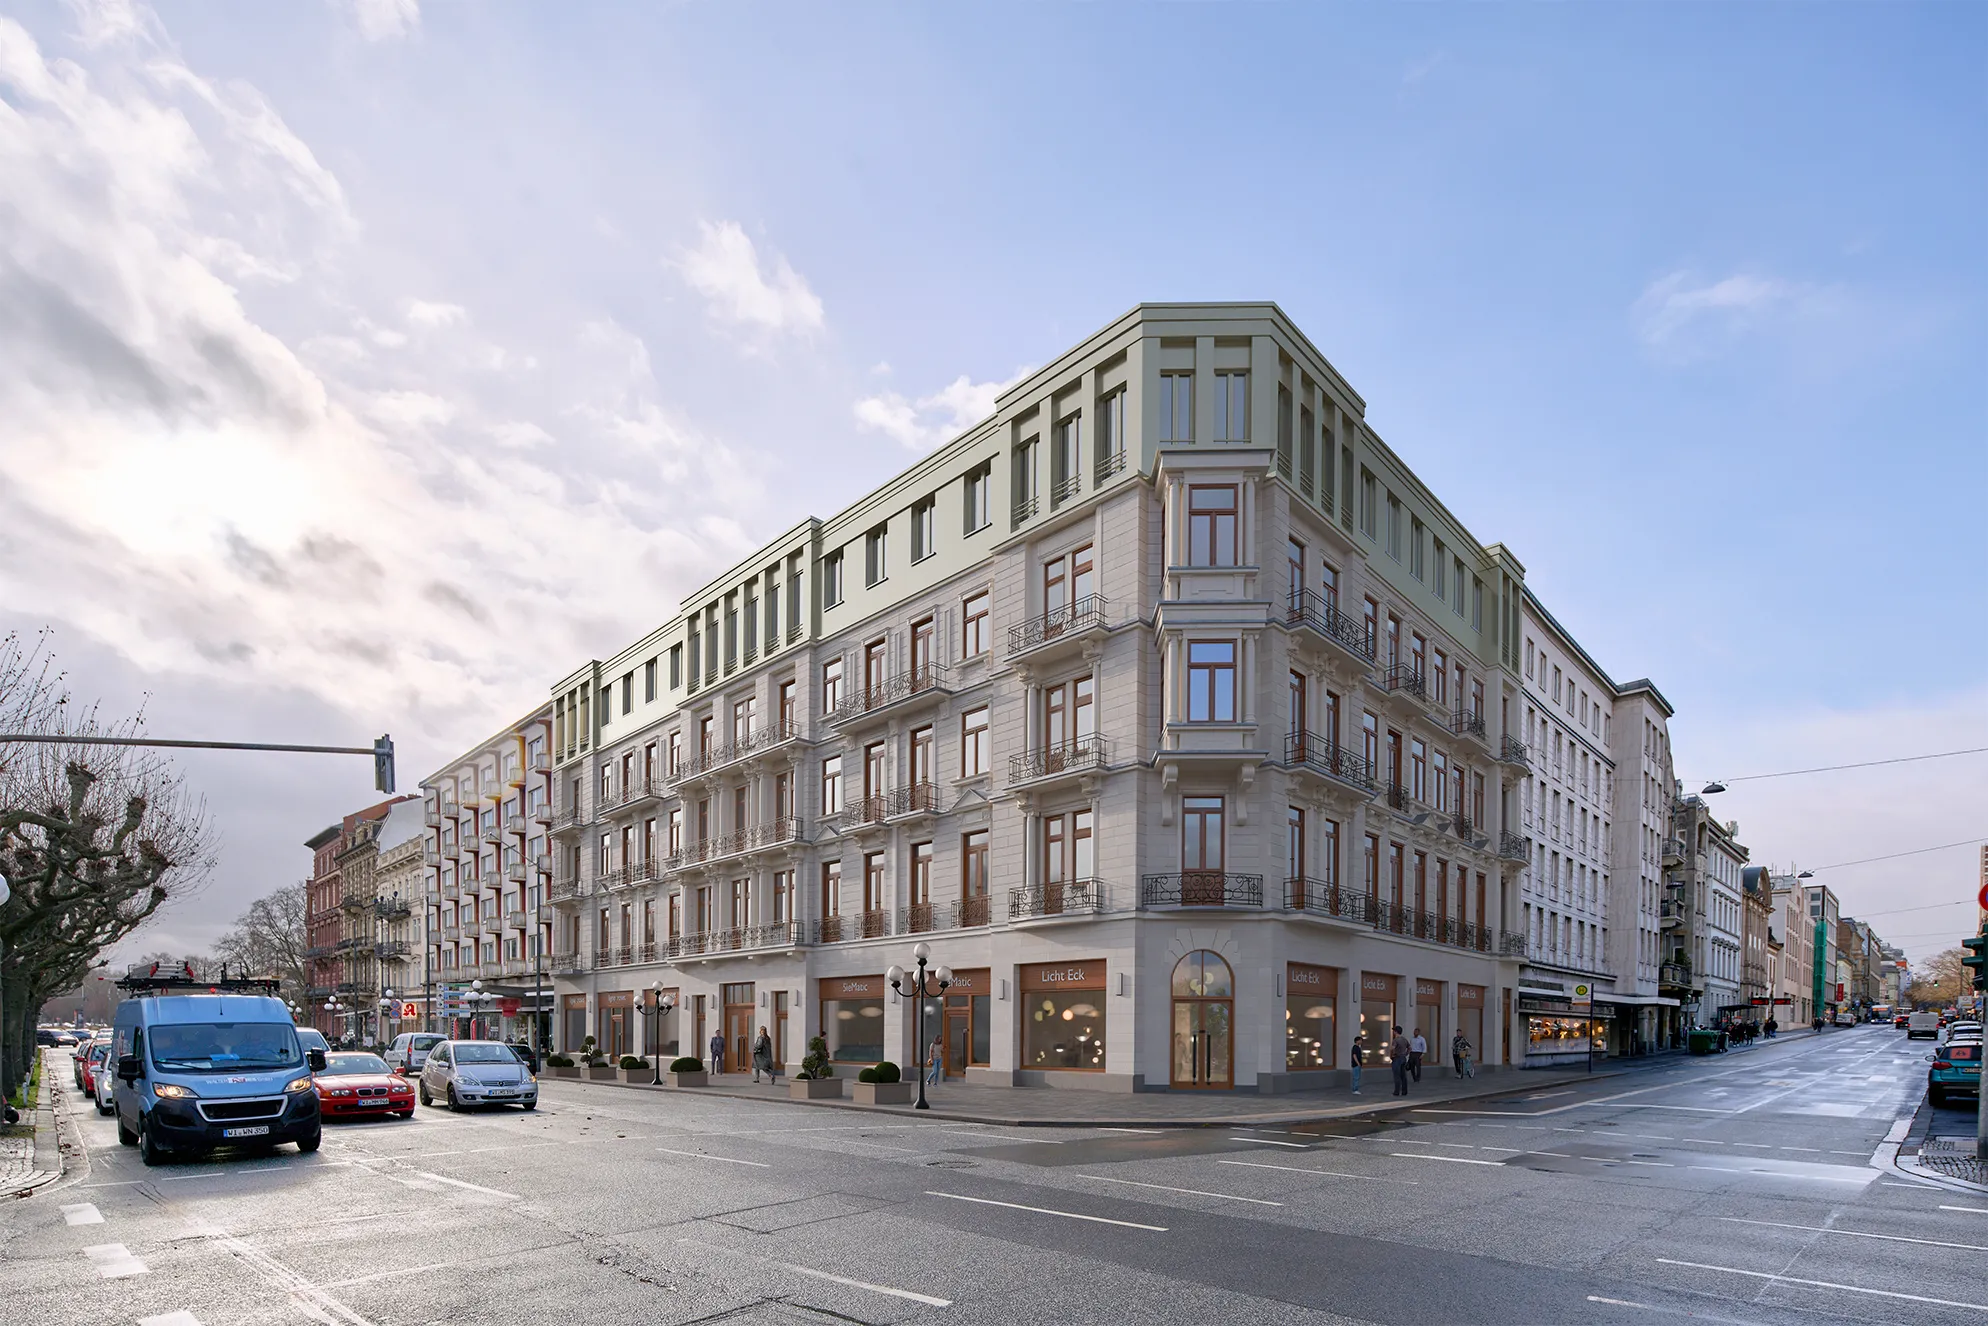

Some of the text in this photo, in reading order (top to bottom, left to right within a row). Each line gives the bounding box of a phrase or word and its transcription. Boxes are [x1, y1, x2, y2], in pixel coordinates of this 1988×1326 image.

[1041, 968, 1085, 982] Licht Eck
[1292, 967, 1320, 984] Licht Eck
